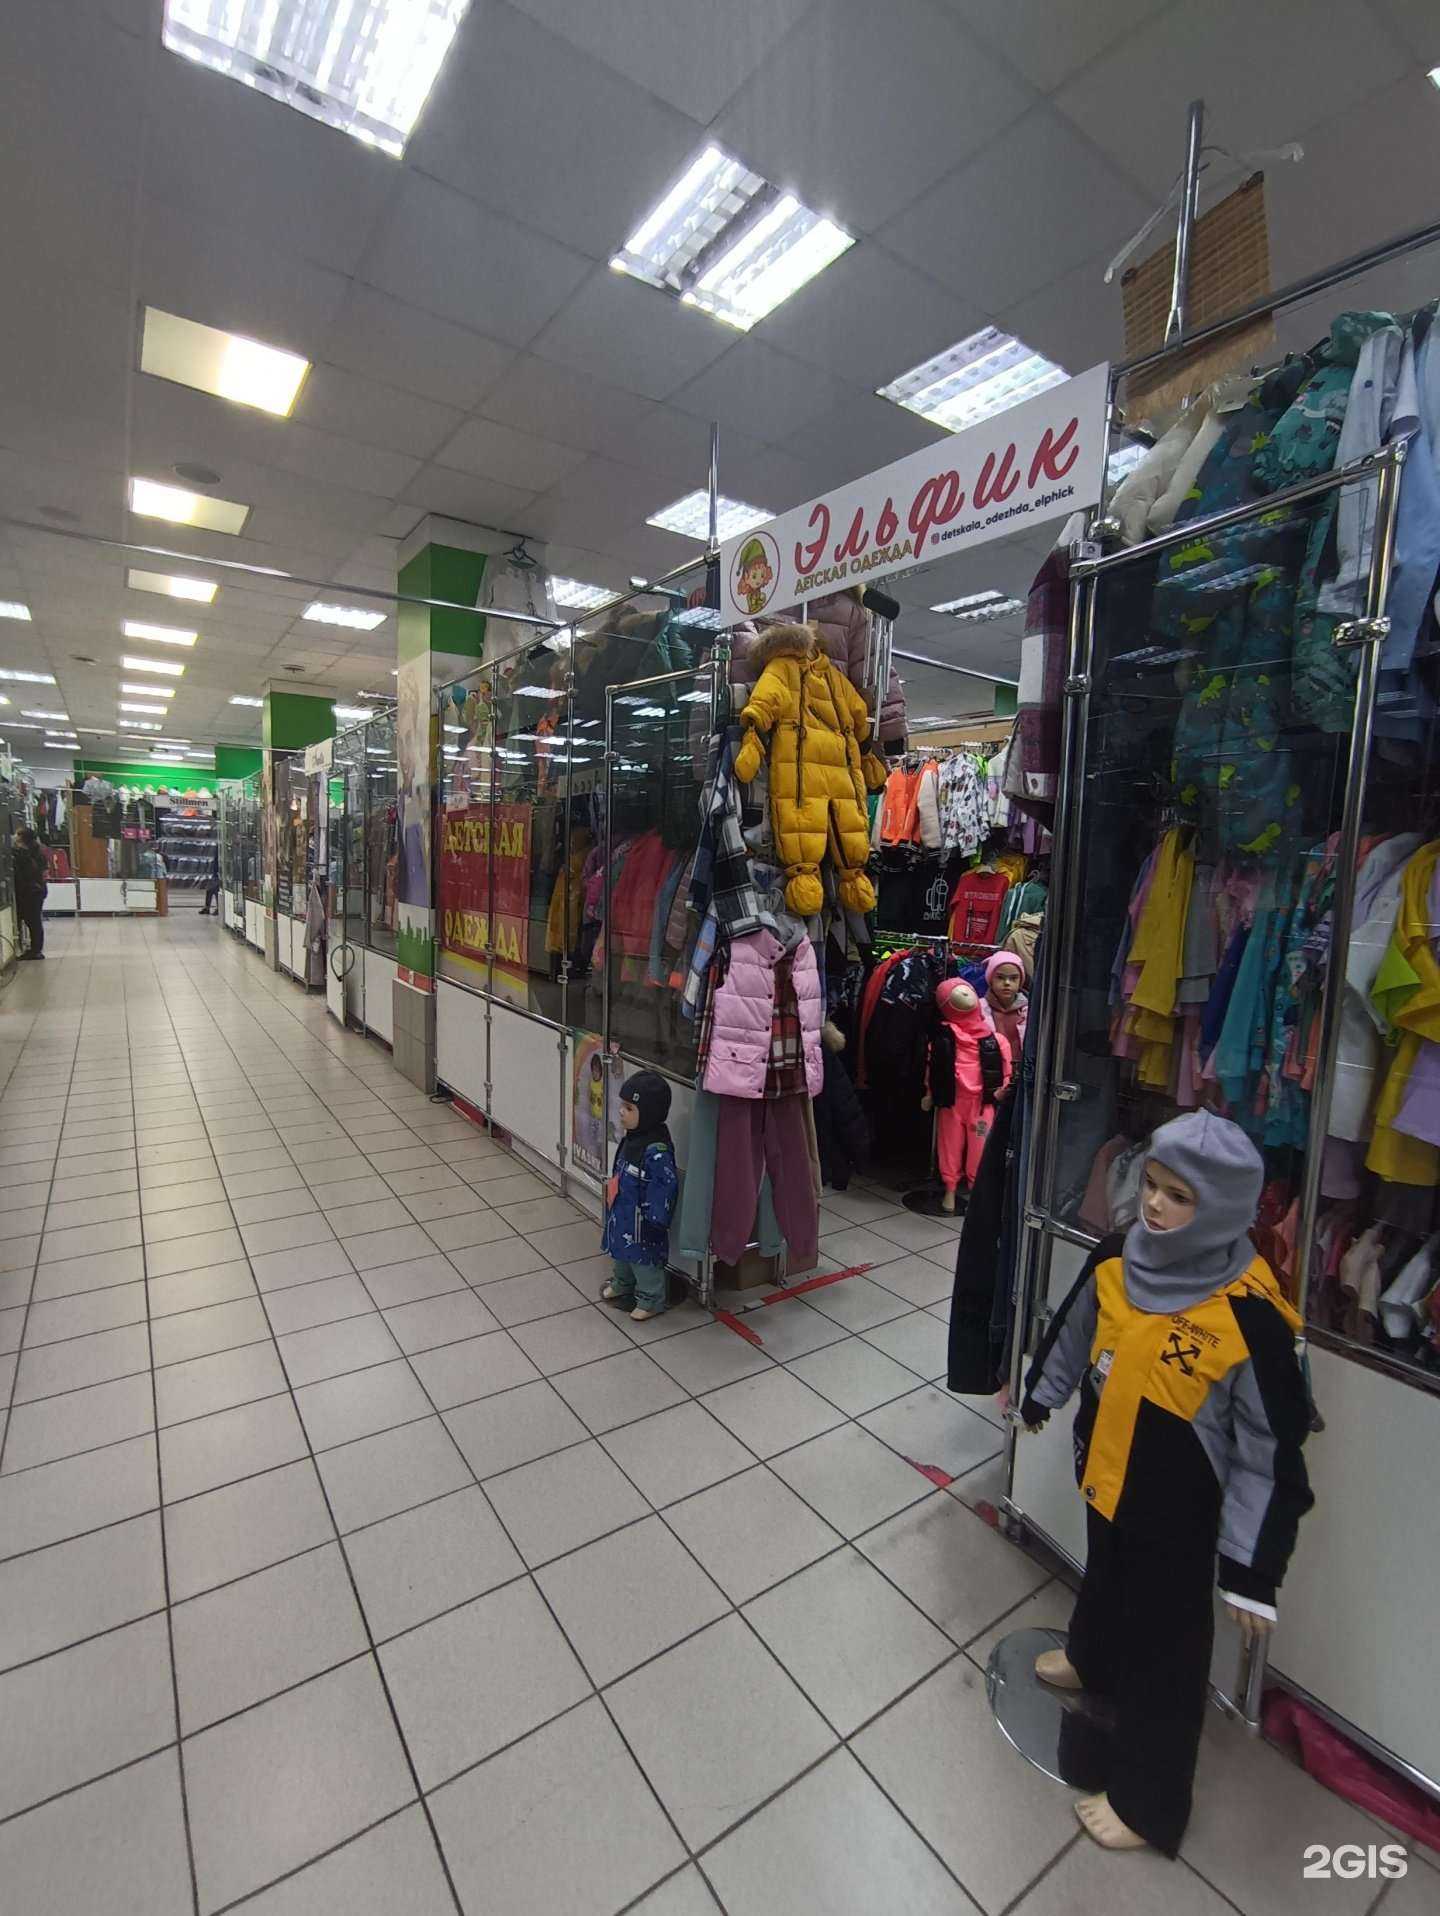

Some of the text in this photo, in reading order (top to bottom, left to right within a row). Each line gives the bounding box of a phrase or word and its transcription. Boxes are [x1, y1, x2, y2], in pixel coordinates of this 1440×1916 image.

[794, 417, 1079, 575] Эльфик
[941, 485, 1075, 541] detskaia_odezhda_elphick
[794, 539, 913, 596] ДЕТСКАЯ ОДЕЖДА
[1171, 1315, 1221, 1349] OFF-WHITE
